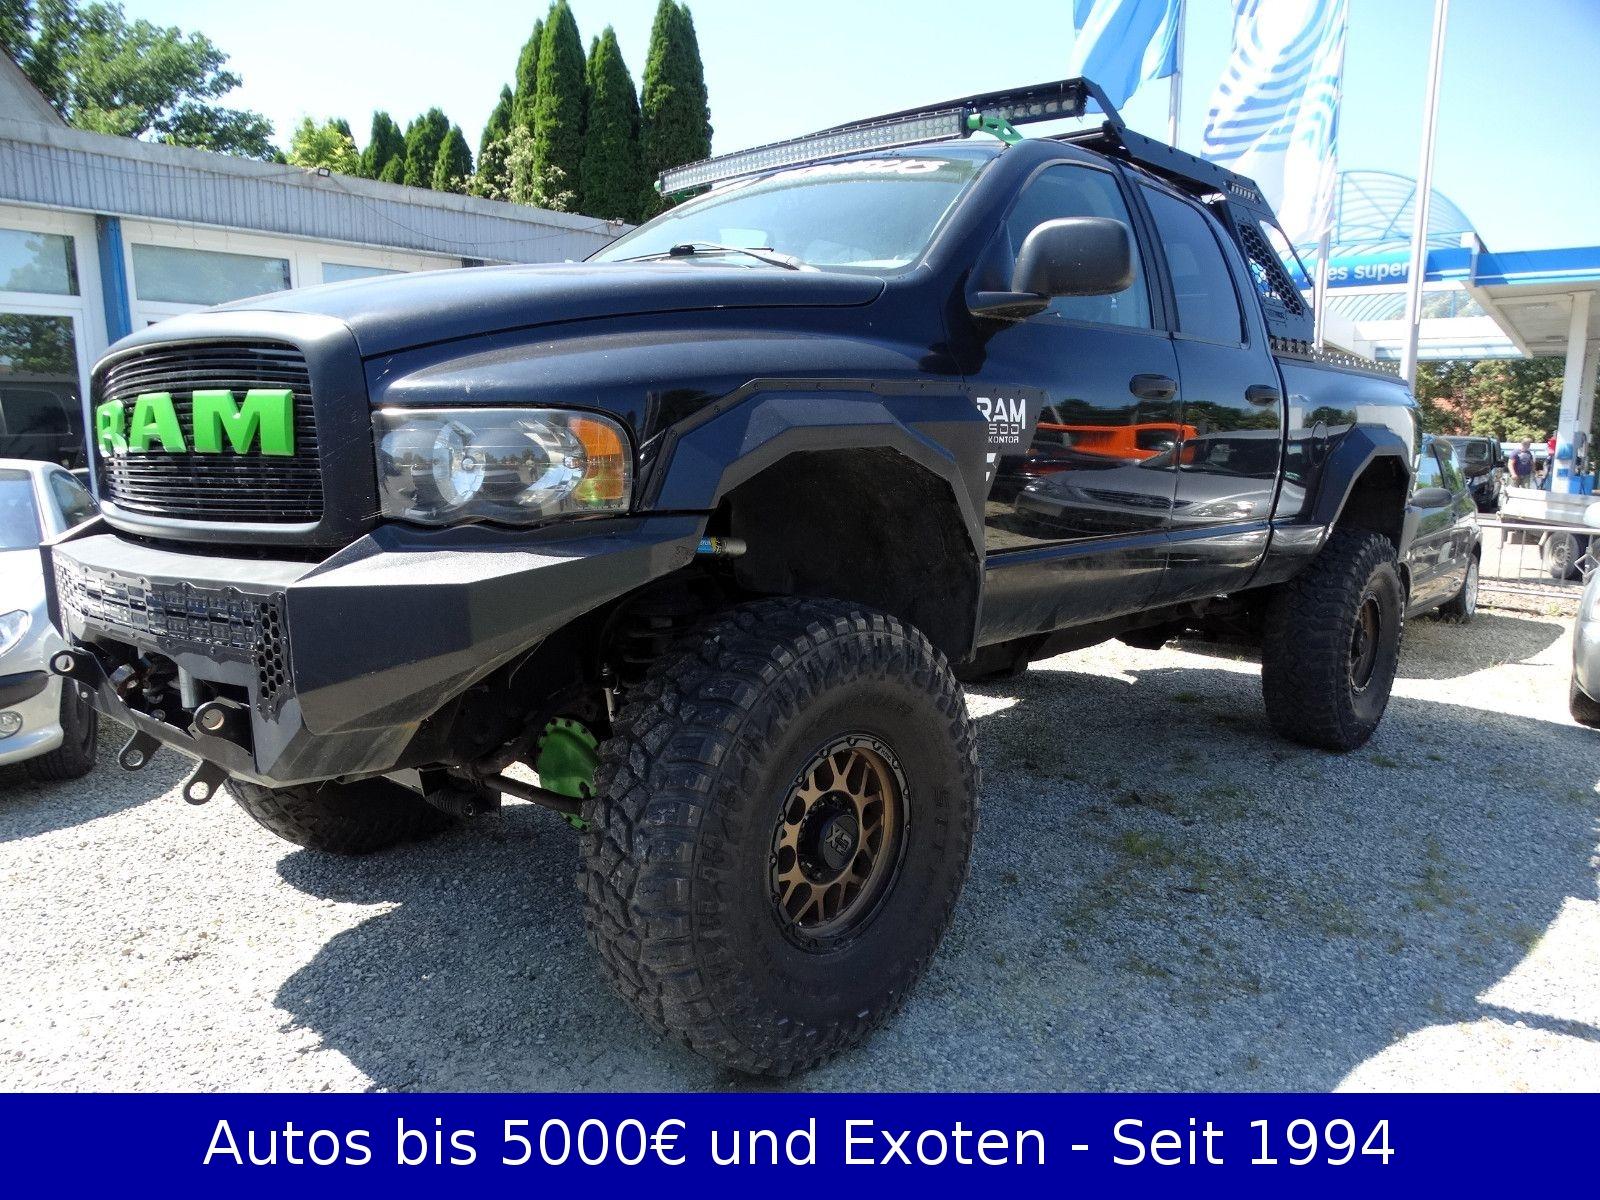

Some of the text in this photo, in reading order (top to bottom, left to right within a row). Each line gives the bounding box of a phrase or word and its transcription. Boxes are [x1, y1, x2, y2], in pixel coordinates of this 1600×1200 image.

[96, 389, 294, 458] RAM
[976, 397, 1026, 430] RAM
[988, 423, 1020, 435] 500
